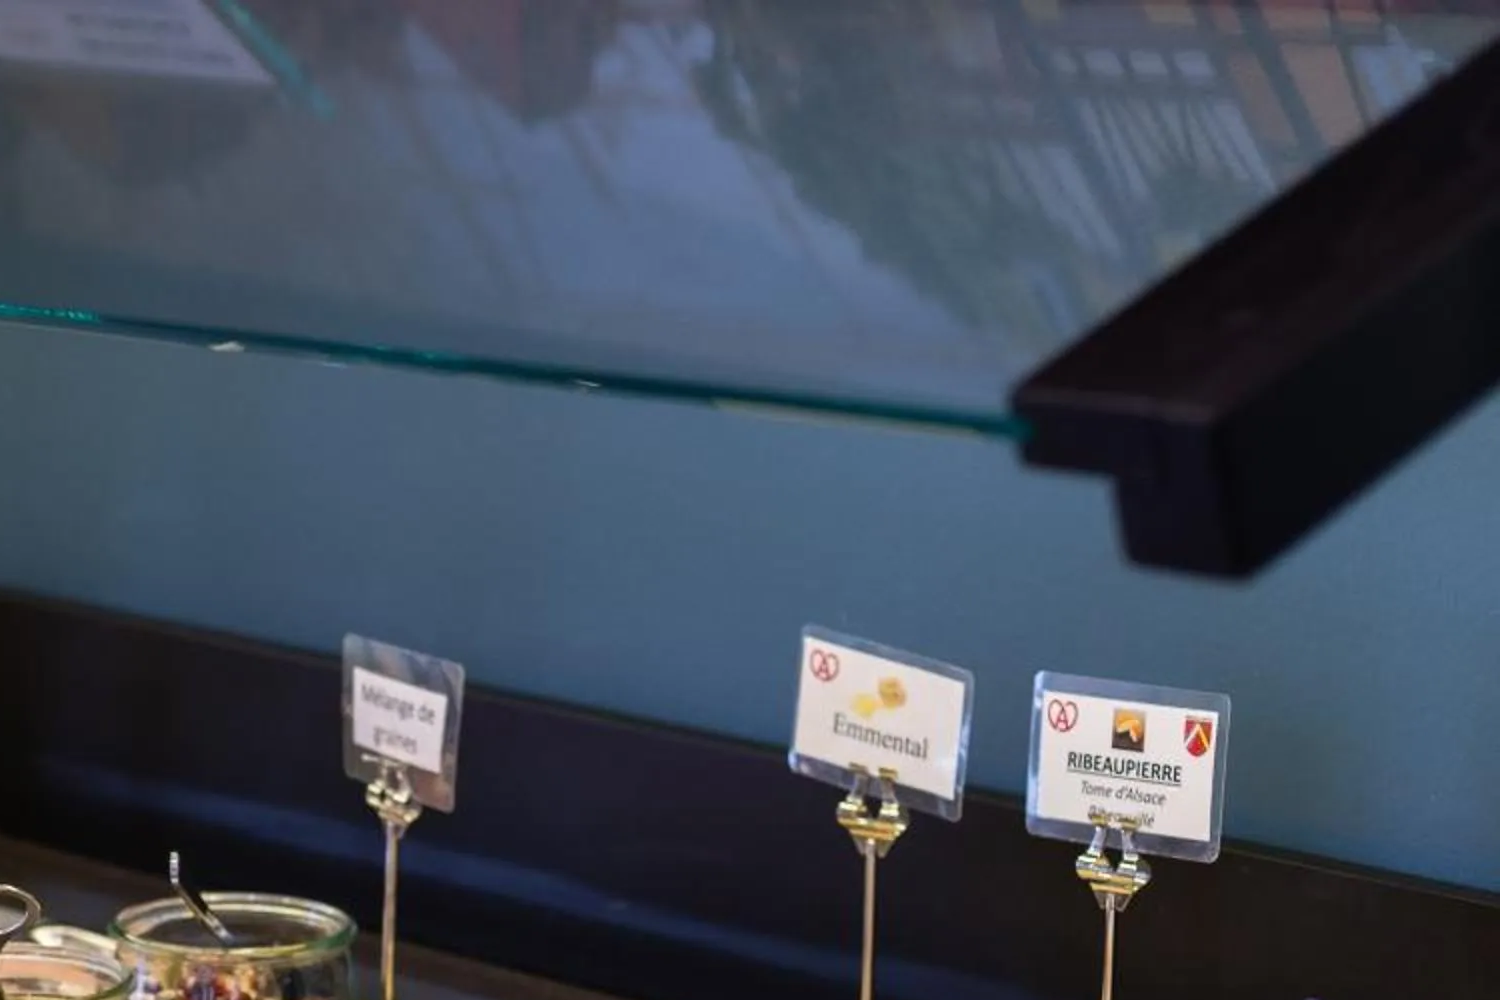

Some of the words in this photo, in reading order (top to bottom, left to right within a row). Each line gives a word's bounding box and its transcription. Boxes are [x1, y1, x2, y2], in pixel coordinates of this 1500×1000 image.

[833, 712, 930, 760] Emmental
[1067, 751, 1183, 783] RIBEAUPIERRE
[1081, 780, 1113, 798] Tome
[1115, 785, 1167, 806] d'Alsace
